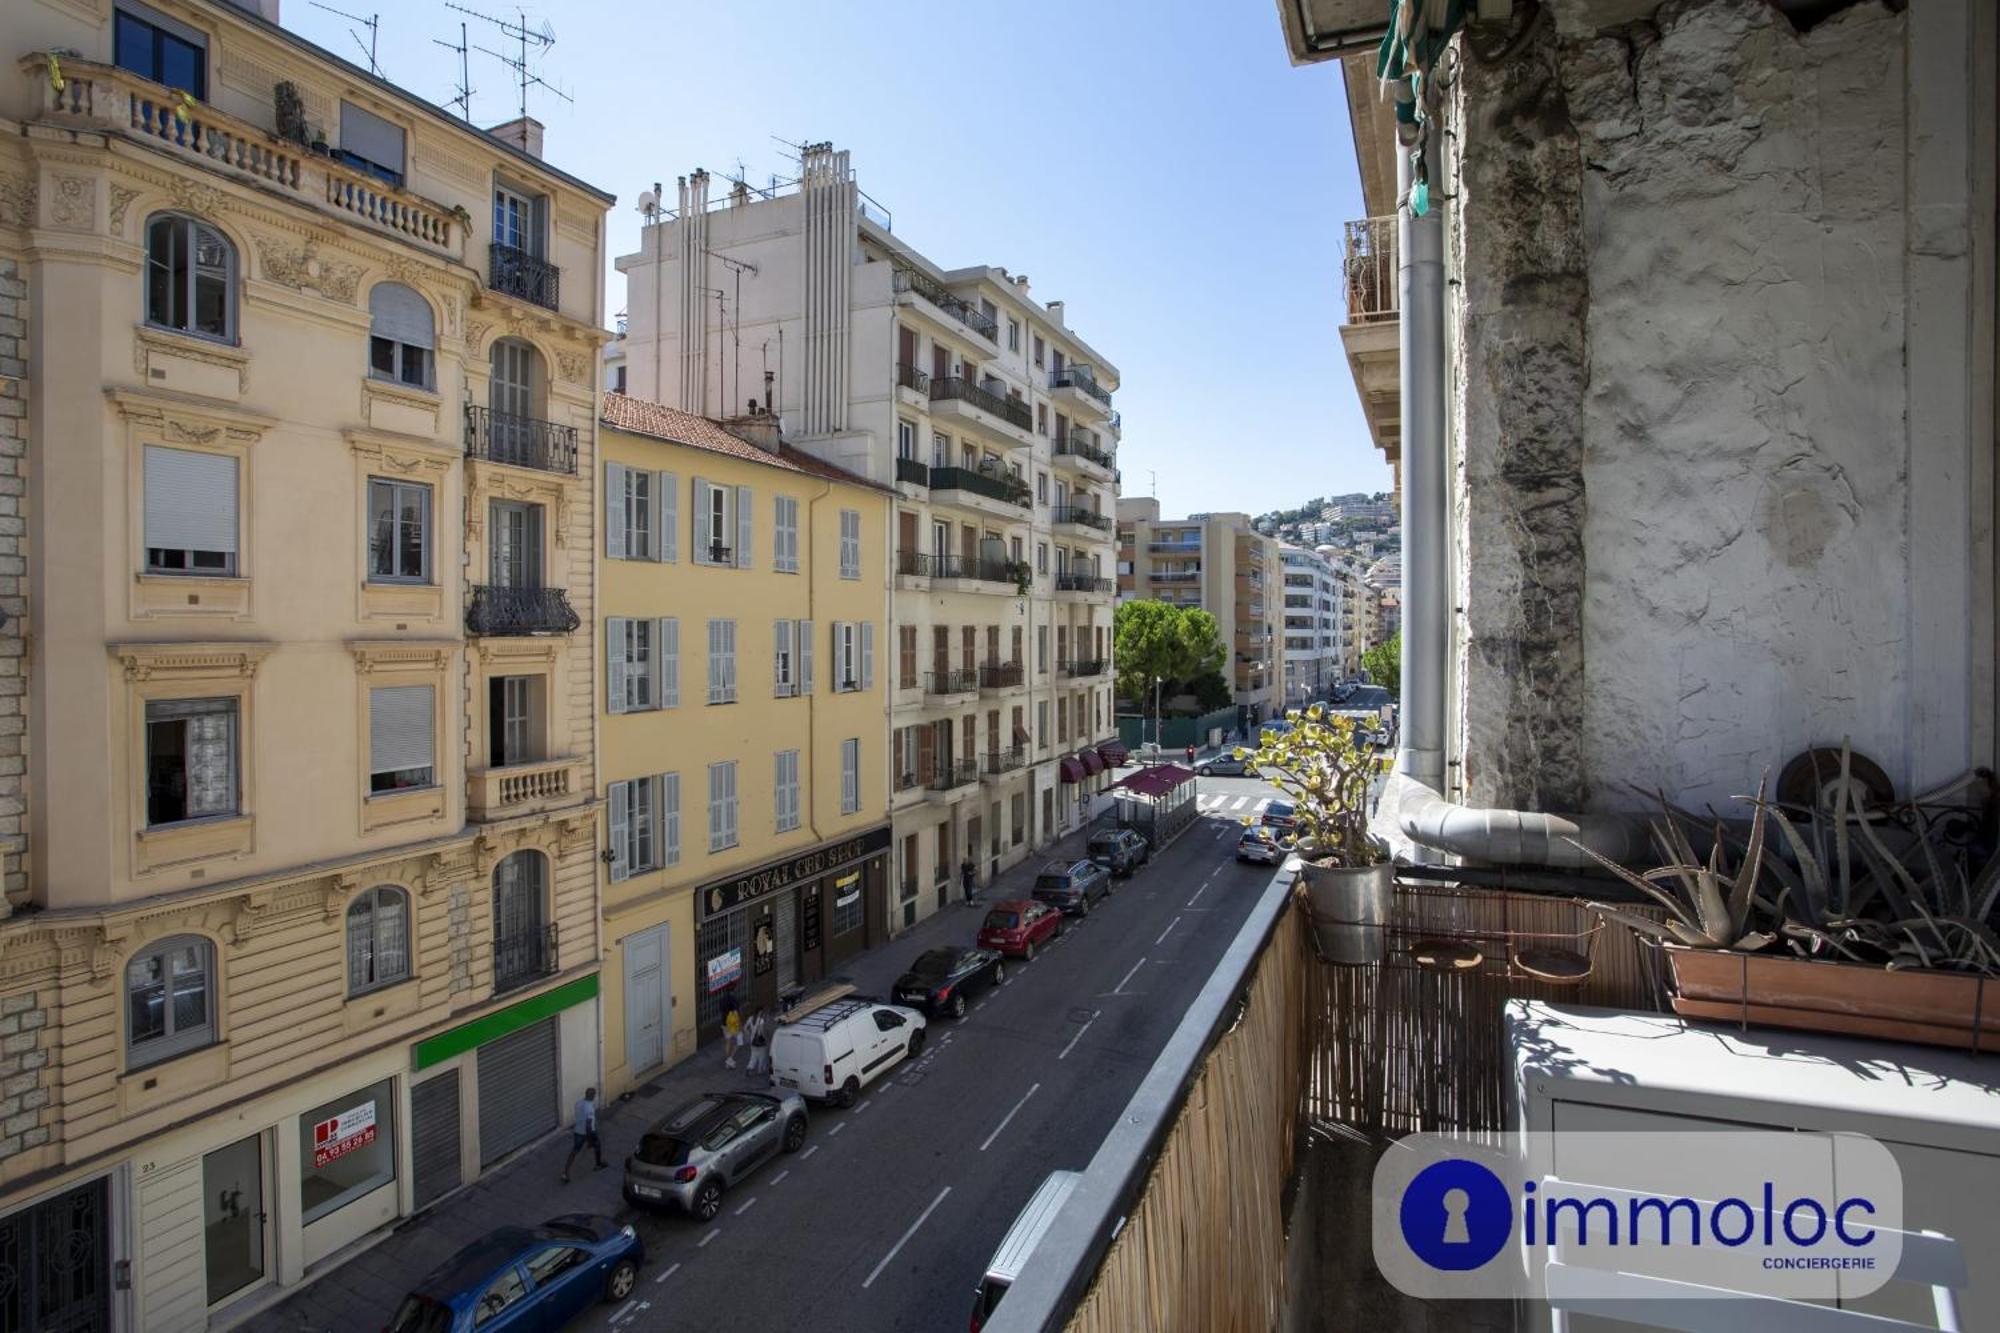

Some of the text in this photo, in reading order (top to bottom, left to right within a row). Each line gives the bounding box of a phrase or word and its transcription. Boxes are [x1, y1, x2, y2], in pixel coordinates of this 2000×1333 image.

[737, 840, 865, 901] ROYAL CBD SHOP
[142, 1162, 156, 1173] 23
